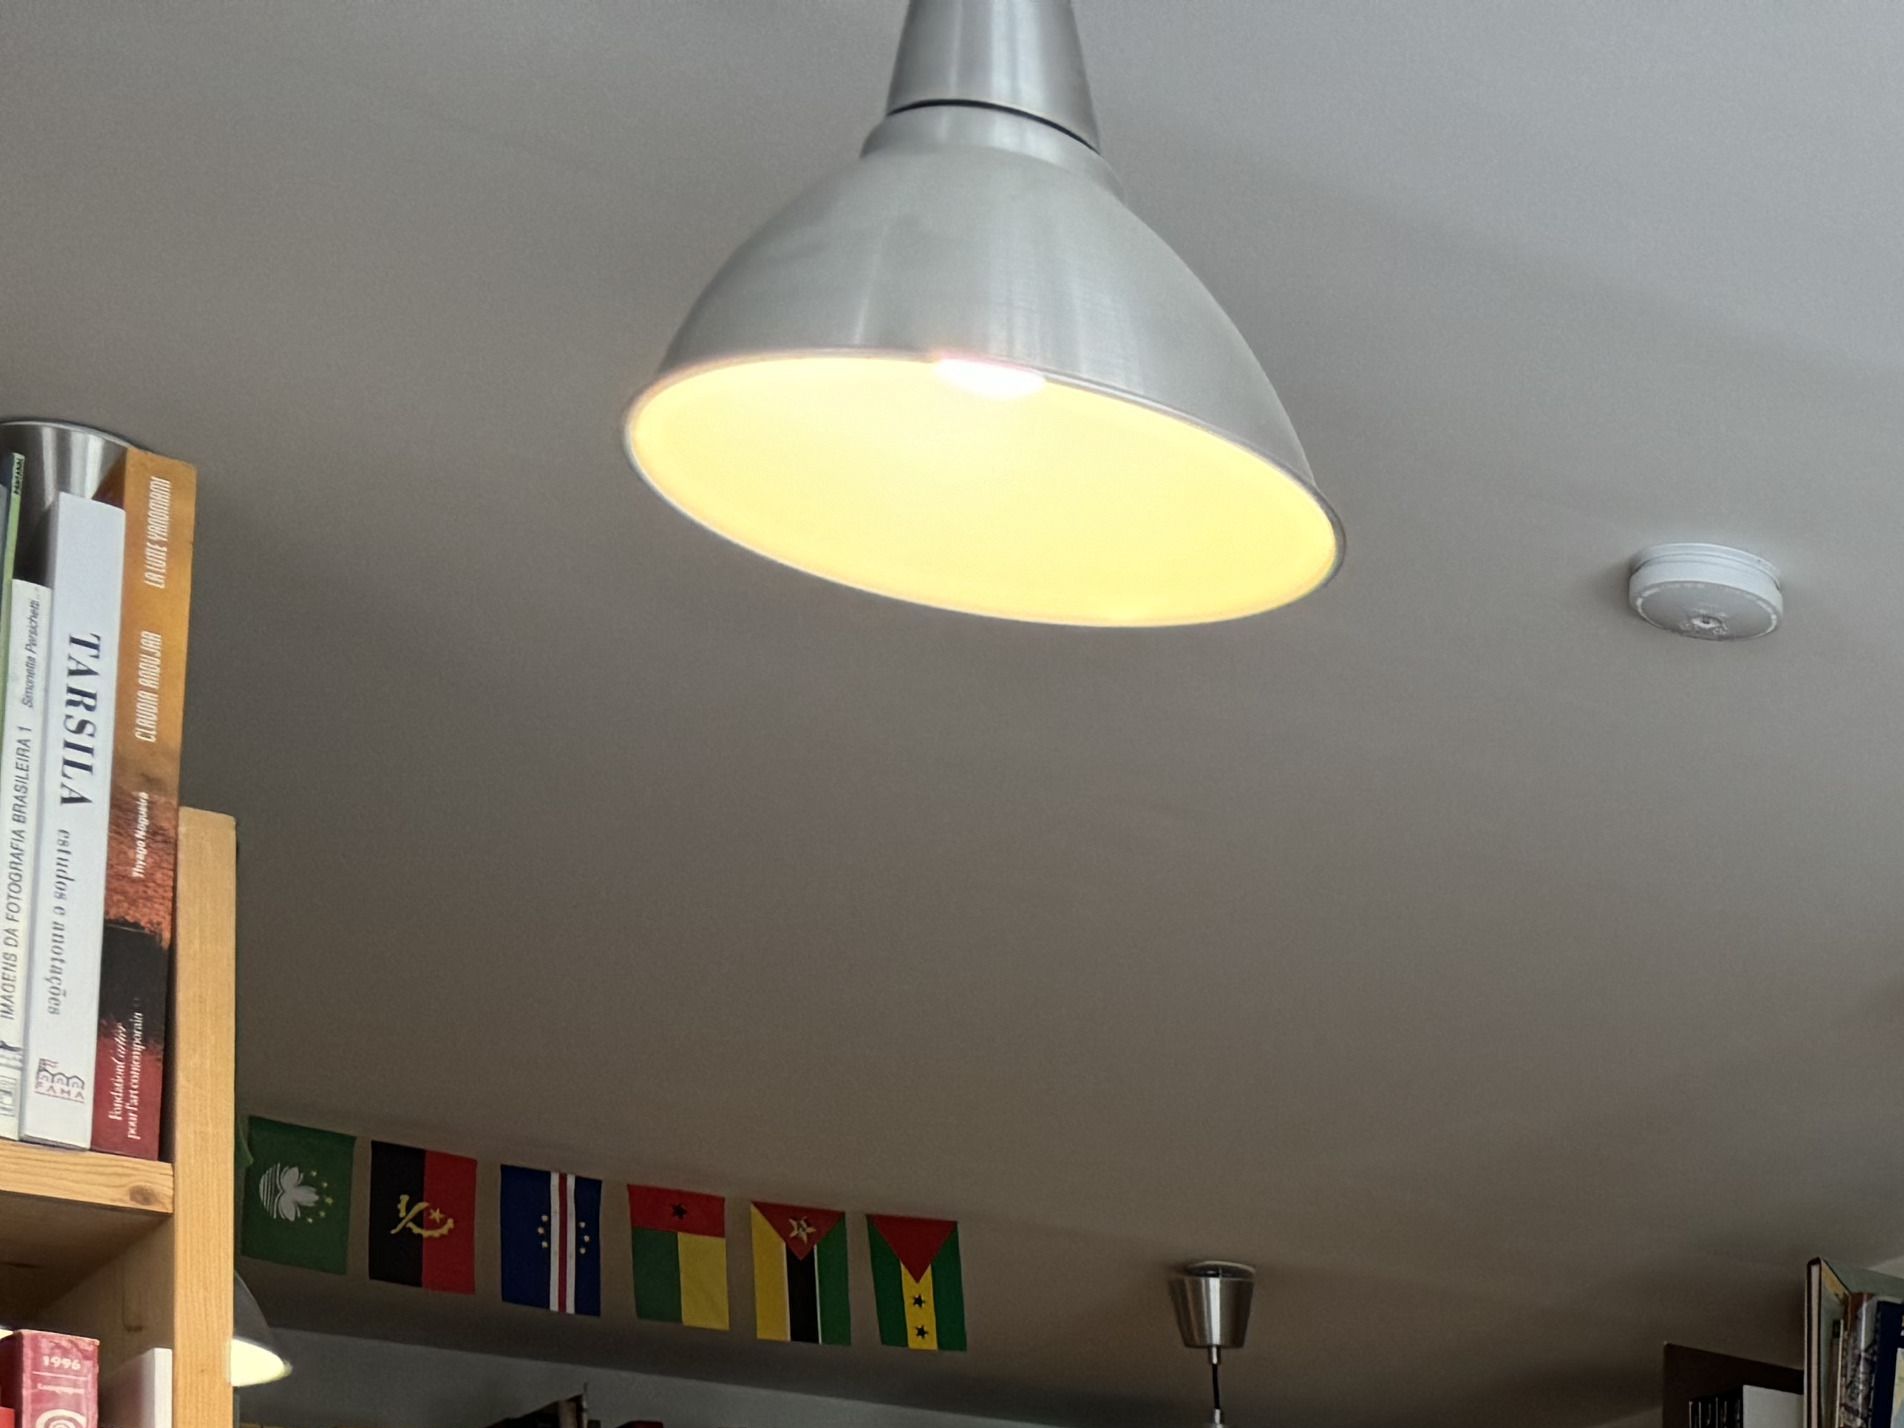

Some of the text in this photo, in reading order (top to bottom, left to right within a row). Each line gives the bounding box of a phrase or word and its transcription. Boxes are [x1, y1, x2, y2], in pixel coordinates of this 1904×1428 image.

[60, 632, 102, 806] TARSILA
[48, 830, 70, 1015] estudos anotações
[42, 1354, 82, 1371] 1996
